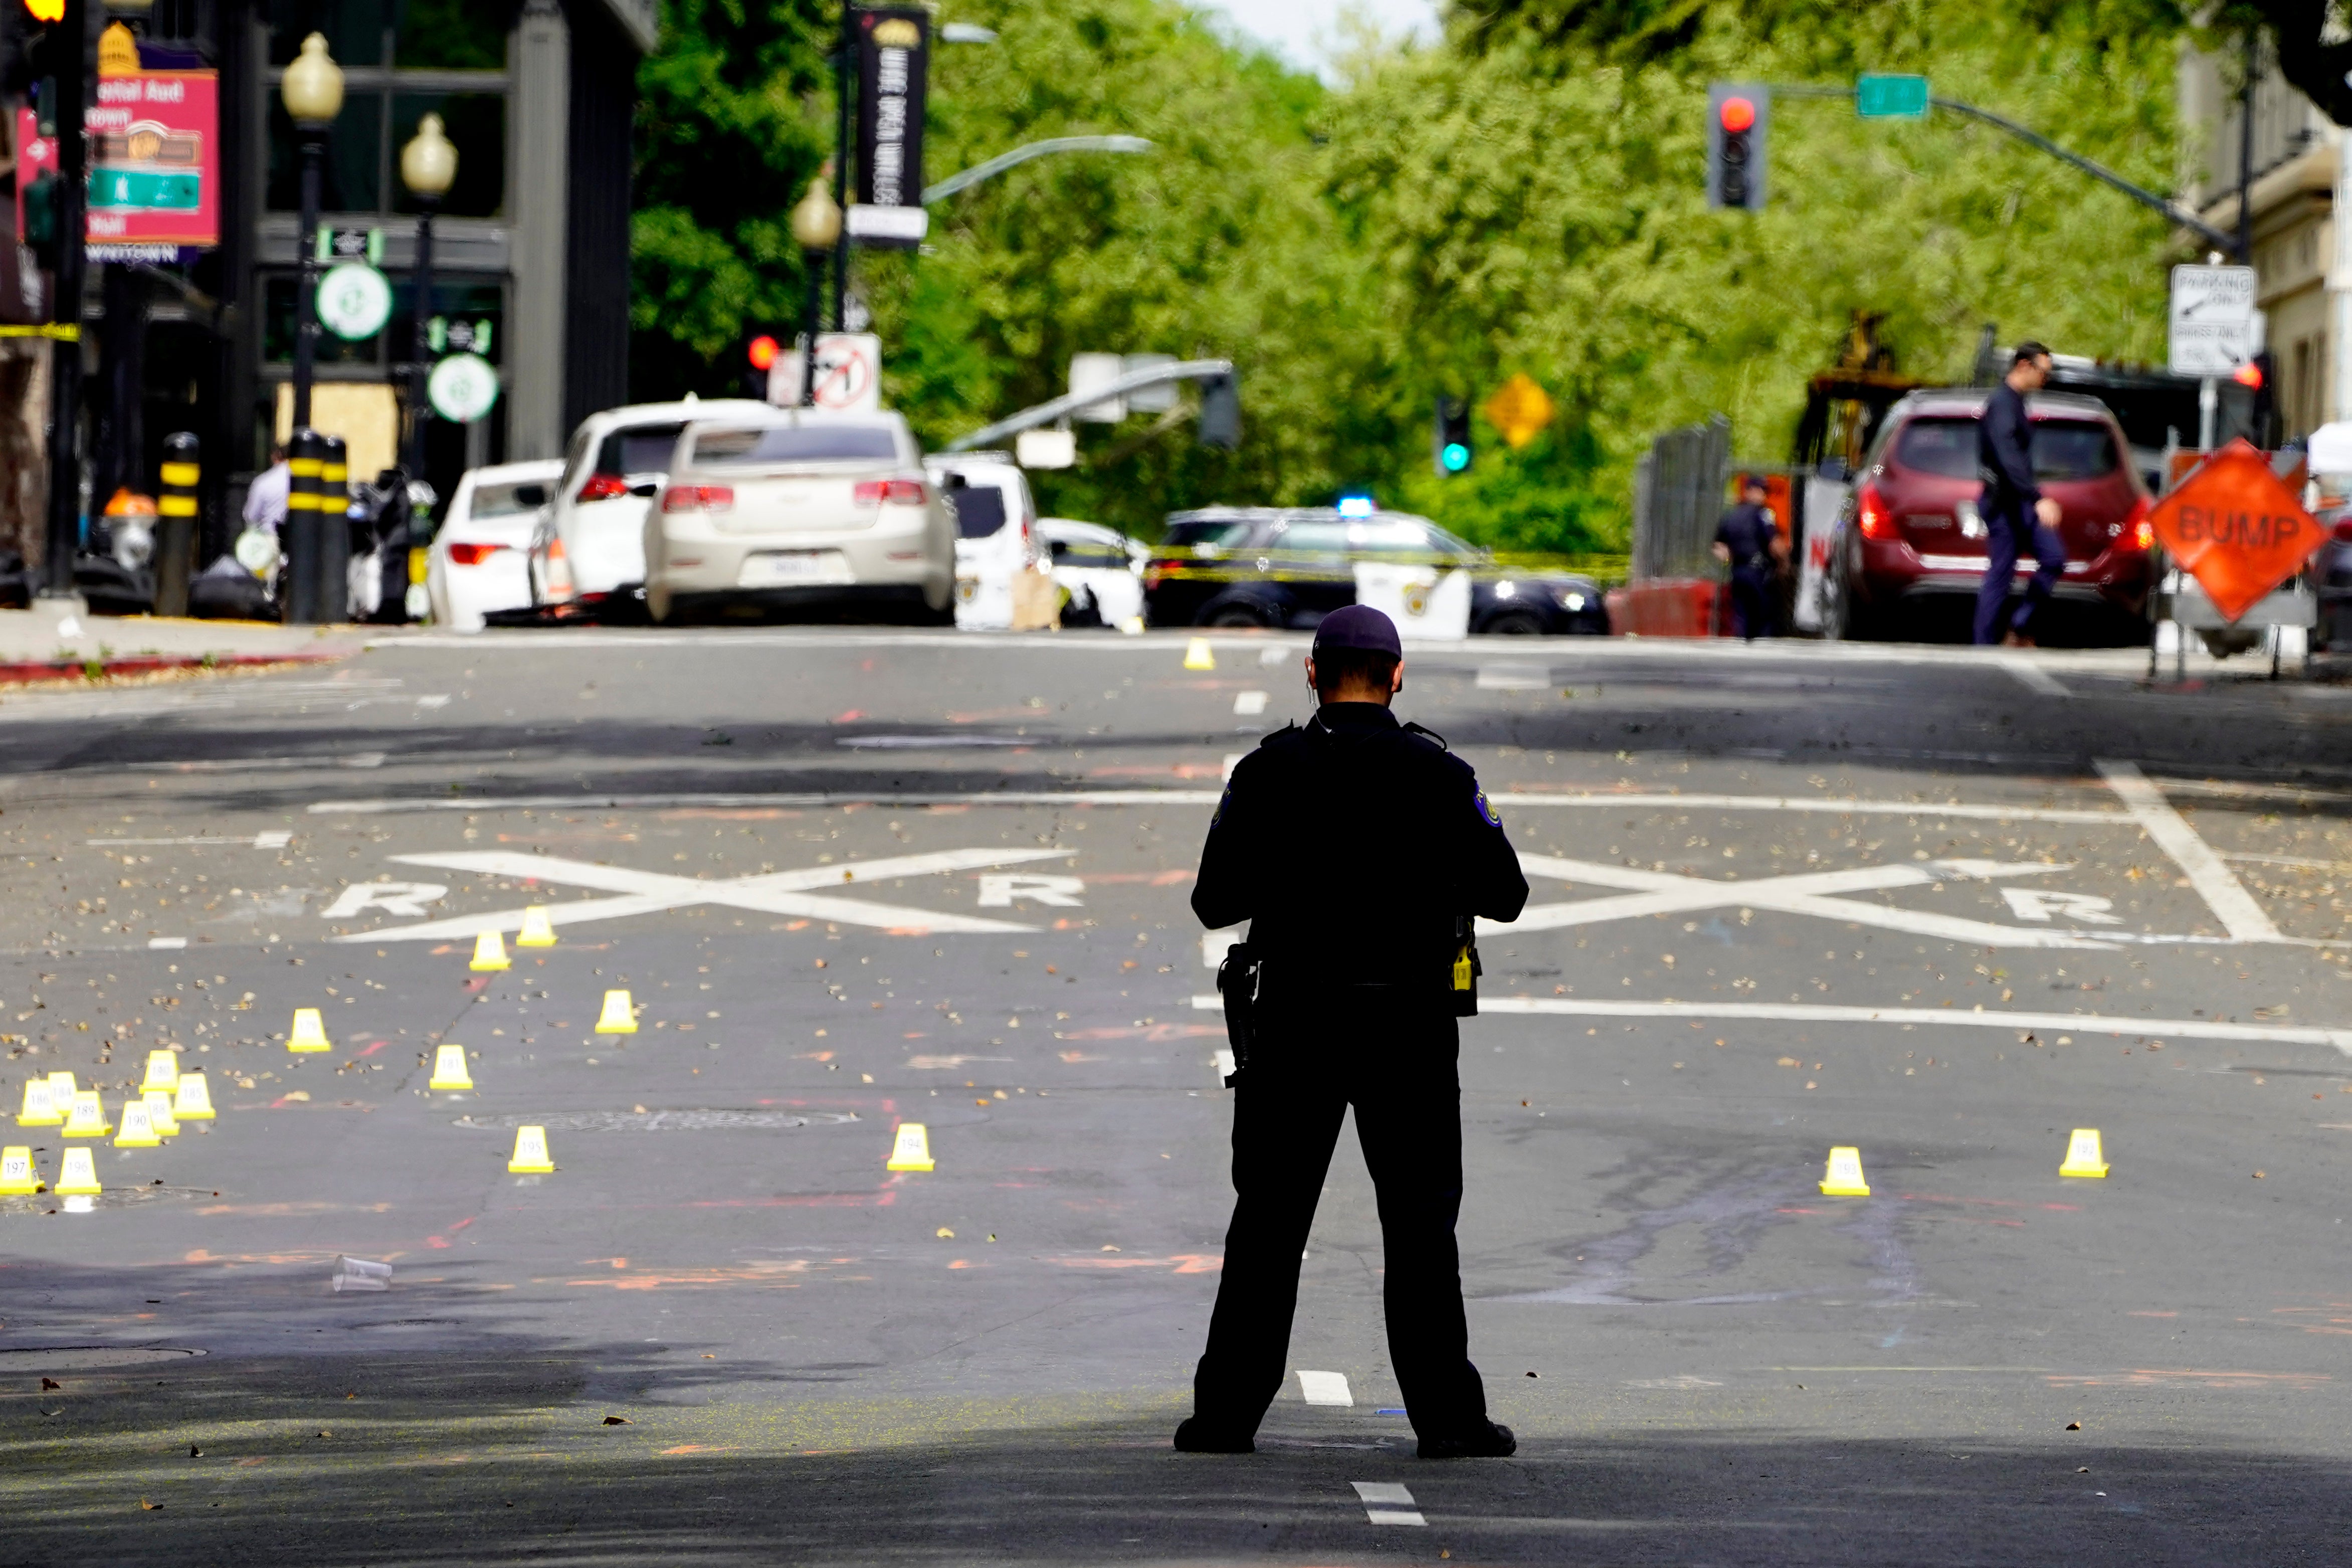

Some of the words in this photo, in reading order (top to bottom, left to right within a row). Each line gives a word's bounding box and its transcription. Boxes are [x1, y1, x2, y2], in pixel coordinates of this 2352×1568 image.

[84, 244, 177, 264] WNTOWN
[2179, 504, 2300, 549] BUMP
[319, 882, 449, 918] R
[977, 874, 1084, 907] R
[1999, 886, 2127, 925] R
[442, 1058, 459, 1069] 181
[76, 1105, 95, 1116] 189
[127, 1114, 146, 1126] 190
[522, 1140, 541, 1153] 195
[902, 1138, 921, 1149] 194
[7, 1161, 25, 1174] 197
[68, 1160, 88, 1172] 196
